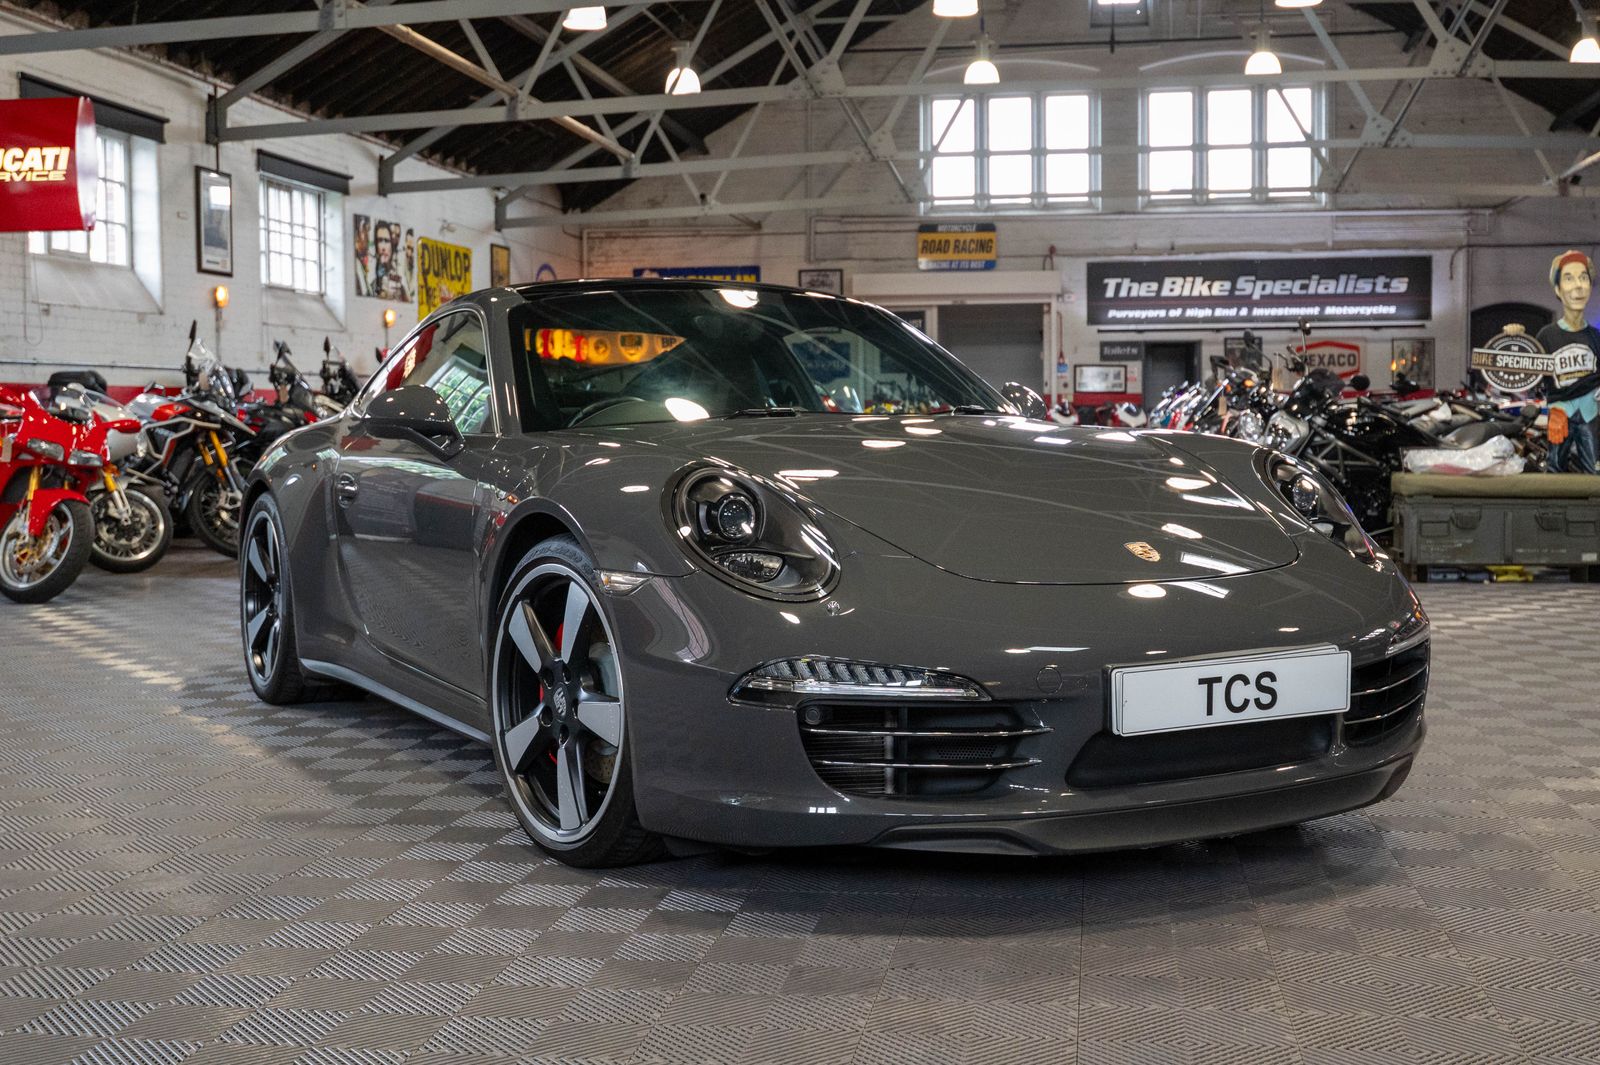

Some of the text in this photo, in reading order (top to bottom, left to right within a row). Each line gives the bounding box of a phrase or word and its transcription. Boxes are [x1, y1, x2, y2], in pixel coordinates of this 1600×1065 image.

[921, 239, 993, 254] ROAD RACING
[421, 243, 471, 285] DUNLOP
[1103, 274, 1409, 300] The Bike Specialists
[1107, 304, 1397, 319] Purveyors of High End & Investment Motorcycles
[1473, 353, 1554, 371] BIKE SPECIALISTS
[1560, 354, 1588, 369] BIKE
[1198, 671, 1278, 716] TCS
